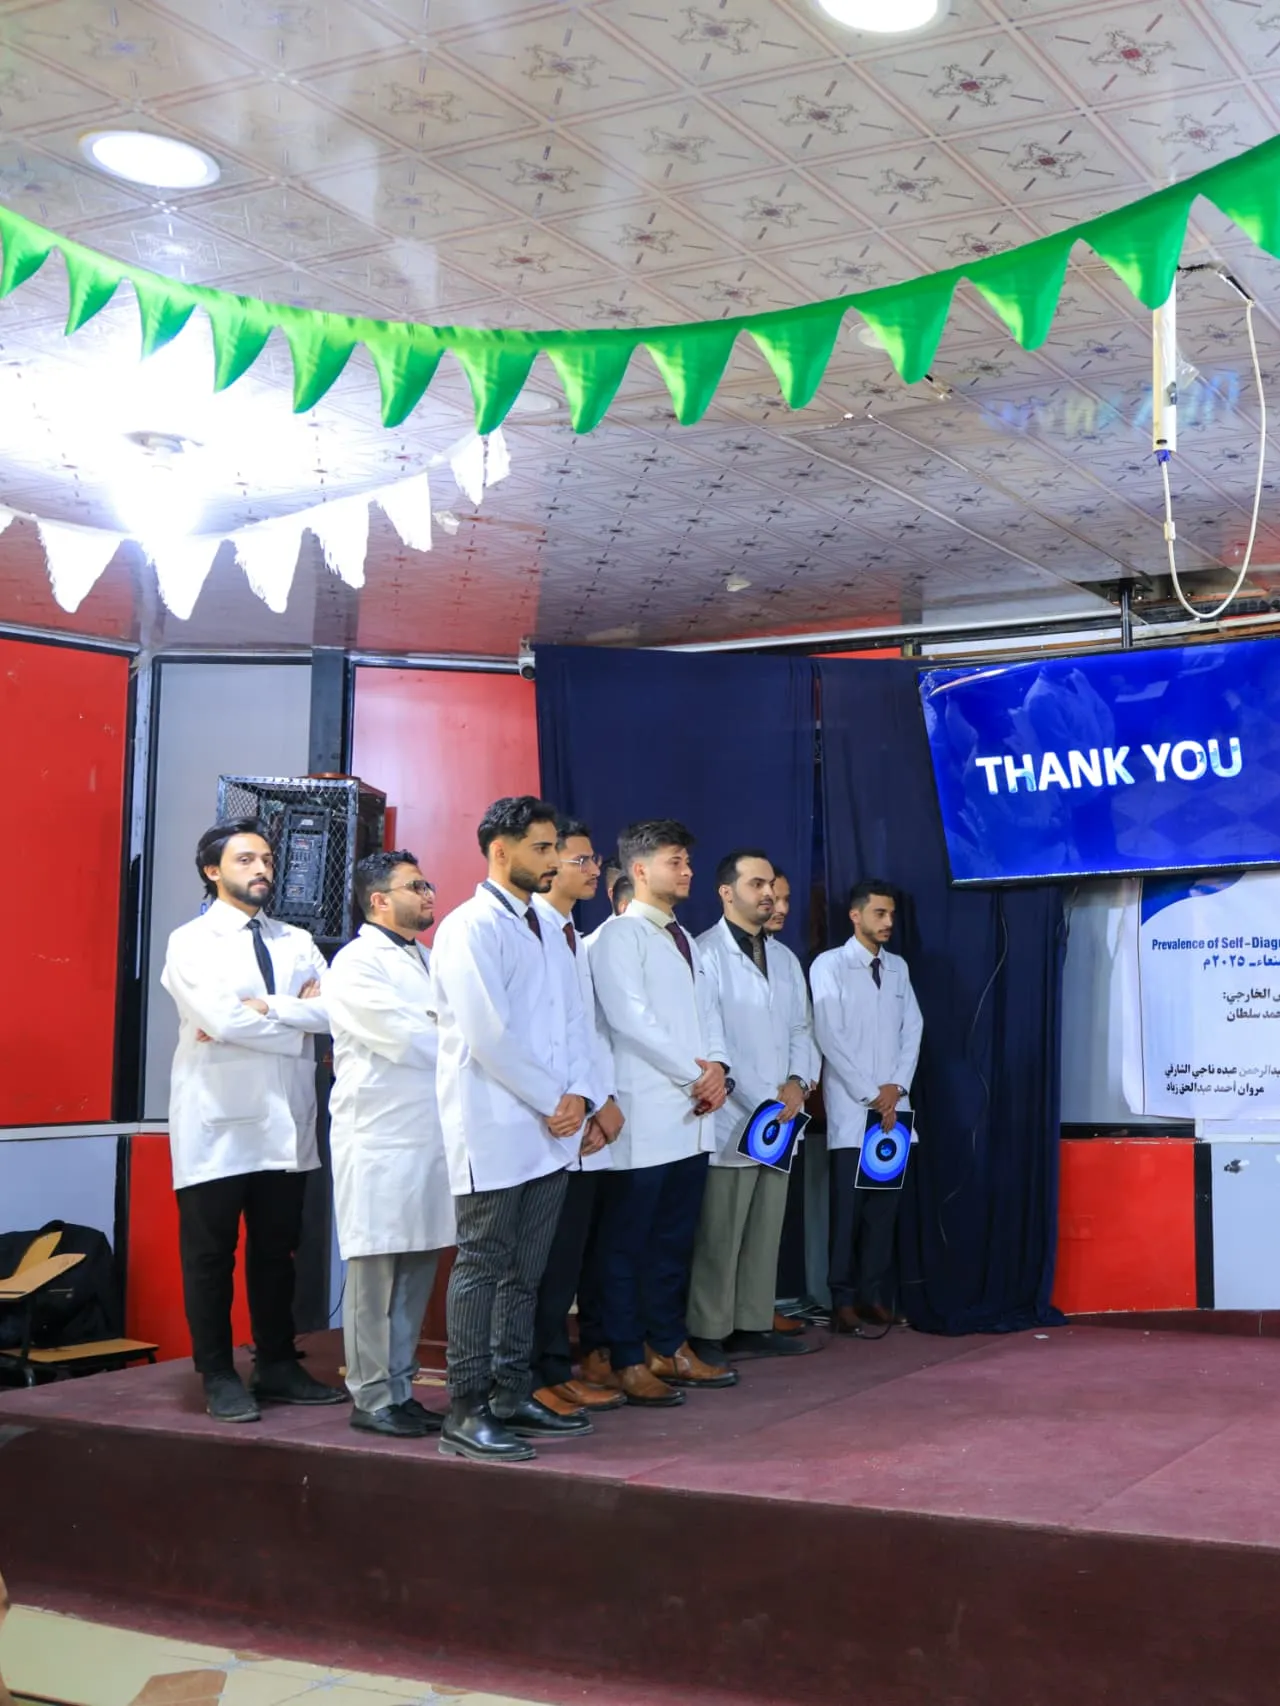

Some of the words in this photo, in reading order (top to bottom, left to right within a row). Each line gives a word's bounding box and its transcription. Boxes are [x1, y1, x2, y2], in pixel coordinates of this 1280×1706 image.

[975, 745, 1135, 795] THANK
[1141, 736, 1243, 782] YOU
[1152, 938, 1205, 950] Prevalence
[1207, 937, 1219, 949] of
[1227, 1007, 1260, 1022] سلطان
[1192, 1064, 1215, 1079] ناجي
[1217, 1066, 1237, 1078] عبده
[1214, 1080, 1237, 1093] أحمد
[1238, 1082, 1265, 1096] مروان
